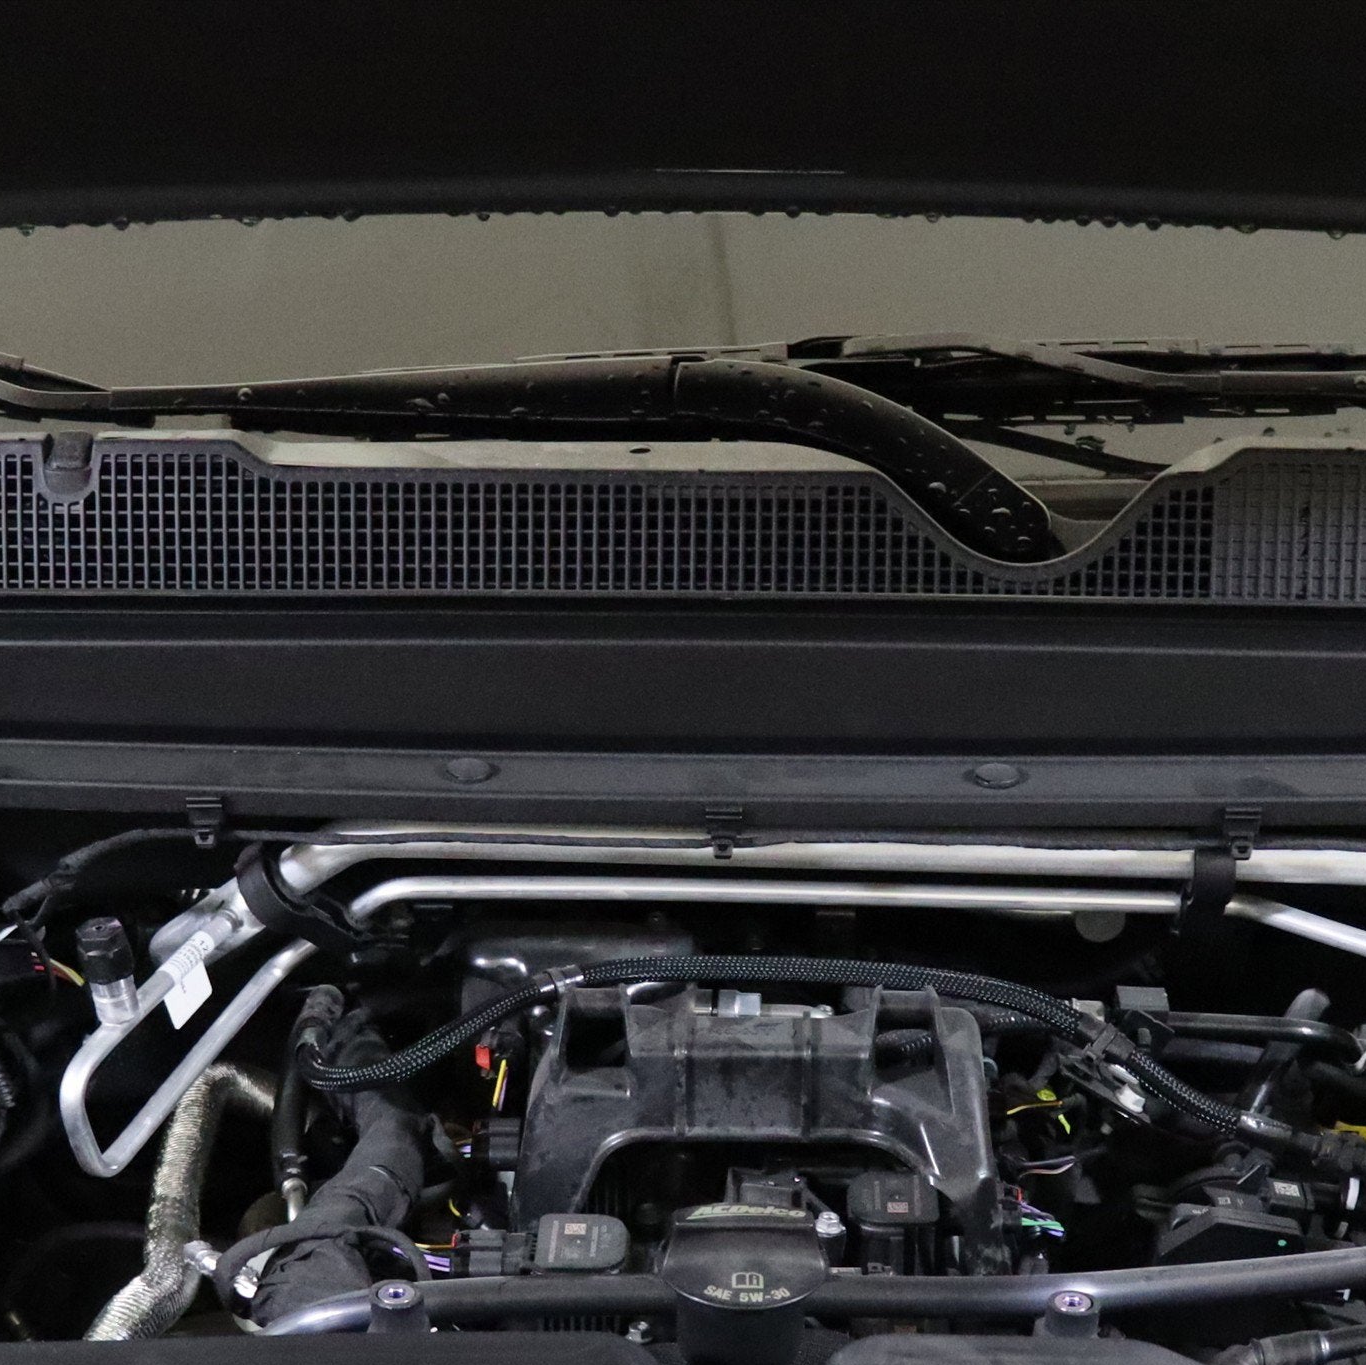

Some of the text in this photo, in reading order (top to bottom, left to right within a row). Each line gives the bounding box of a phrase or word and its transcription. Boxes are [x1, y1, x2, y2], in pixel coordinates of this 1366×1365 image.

[688, 1205, 806, 1219] ACDelco
[703, 1284, 791, 1303] SAE 5W-30
